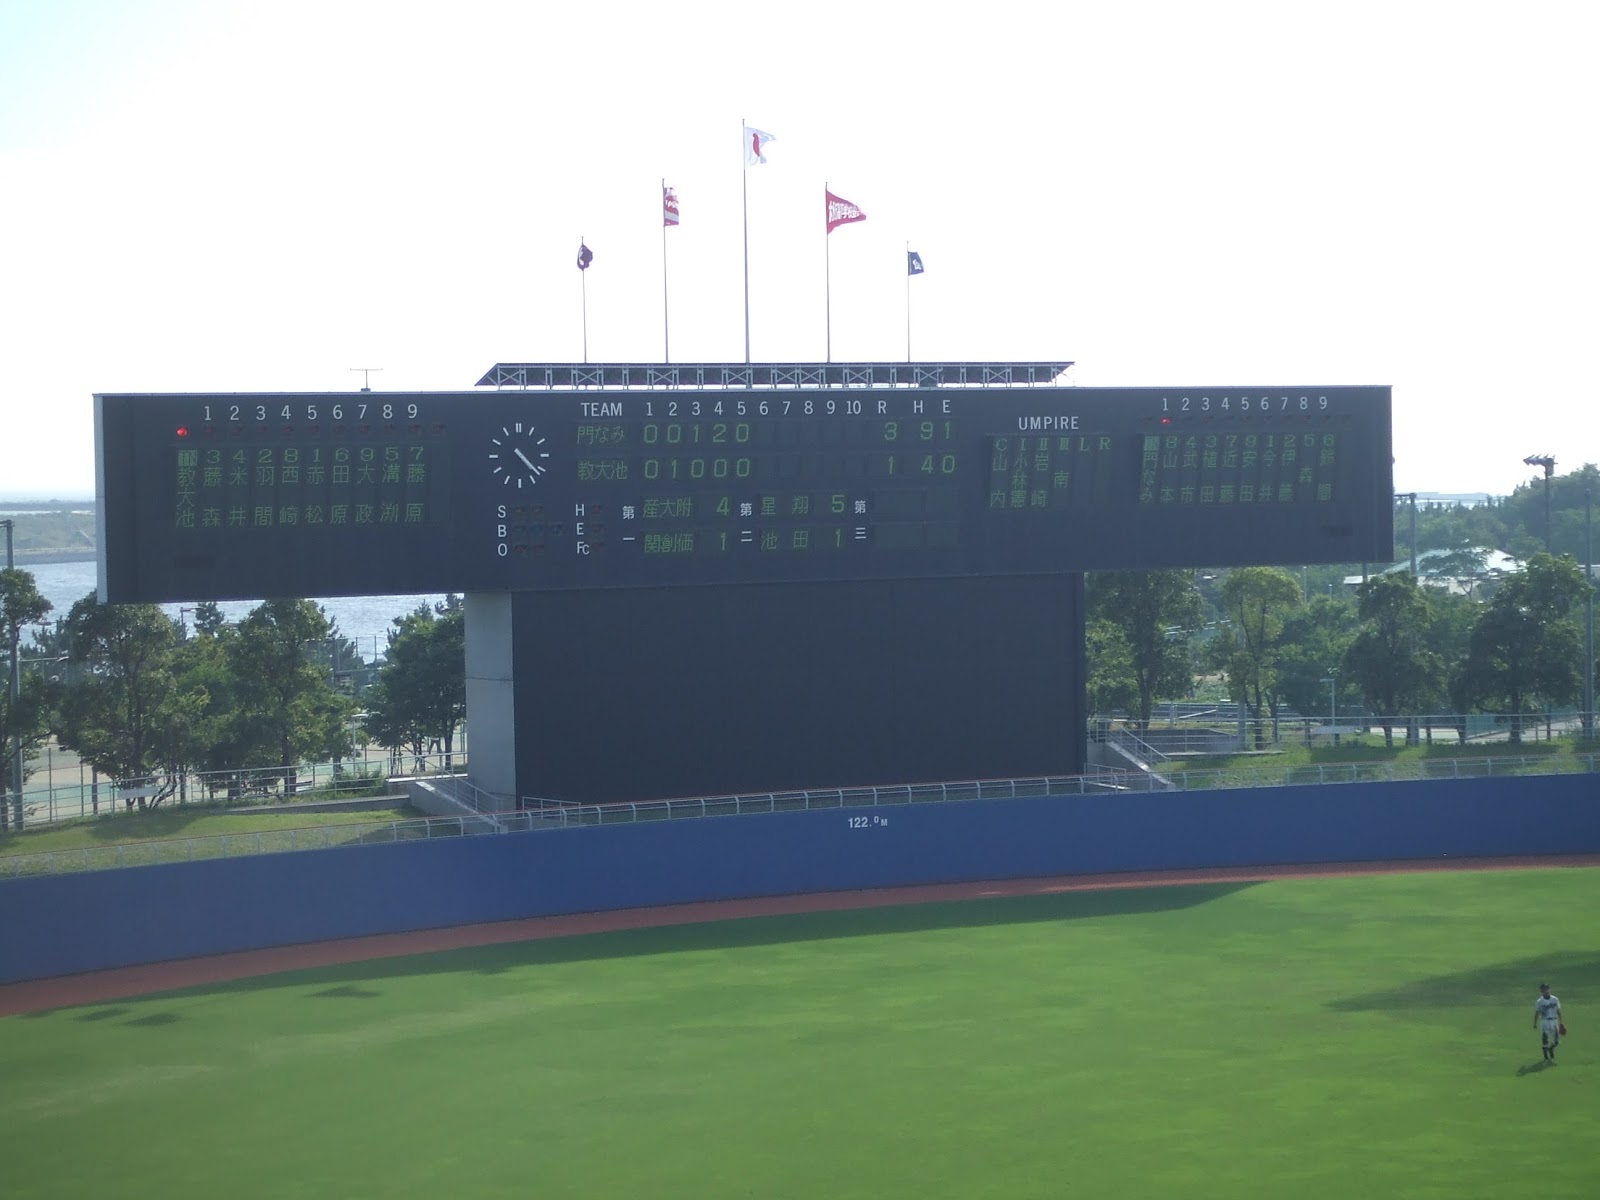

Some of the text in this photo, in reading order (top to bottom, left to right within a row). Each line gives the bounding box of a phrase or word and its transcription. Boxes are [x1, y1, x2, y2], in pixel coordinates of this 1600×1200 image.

[204, 404, 418, 421] 1 2 3 4 5 6 7 8 9
[581, 400, 950, 417] TEAM 1 2 3 4 5 6 7 8 9 10 R H E
[1162, 397, 1327, 411] 1 2 3 4 5 6 7 8 9
[1018, 416, 1079, 430] UMPIRE
[644, 424, 658, 443] 0
[667, 424, 681, 443] 0
[693, 425, 700, 443] 1
[713, 424, 727, 442] 2
[736, 424, 749, 442] 0
[884, 422, 898, 440] 3
[920, 422, 933, 440] 9
[944, 422, 951, 439] 1
[1246, 435, 1257, 447] 9
[1268, 435, 1275, 447] 1
[1284, 435, 1296, 447] 2
[1304, 434, 1315, 447] 5
[207, 450, 221, 464] 3
[232, 449, 245, 463] 4
[258, 449, 273, 463] 2
[284, 449, 298, 462] 8
[312, 449, 321, 462] 1
[335, 448, 349, 462] 6
[360, 448, 375, 462] 9
[385, 448, 399, 461] 5
[410, 447, 425, 461] 7
[577, 455, 955, 480] 教大池 0 1 0 0 0 1 4 0
[498, 505, 506, 518] S
[576, 504, 584, 517] H
[716, 497, 729, 515] 4
[831, 495, 845, 513] 5
[498, 525, 507, 537] B
[577, 523, 584, 536] E
[835, 529, 842, 547] 1
[720, 533, 727, 551] 1
